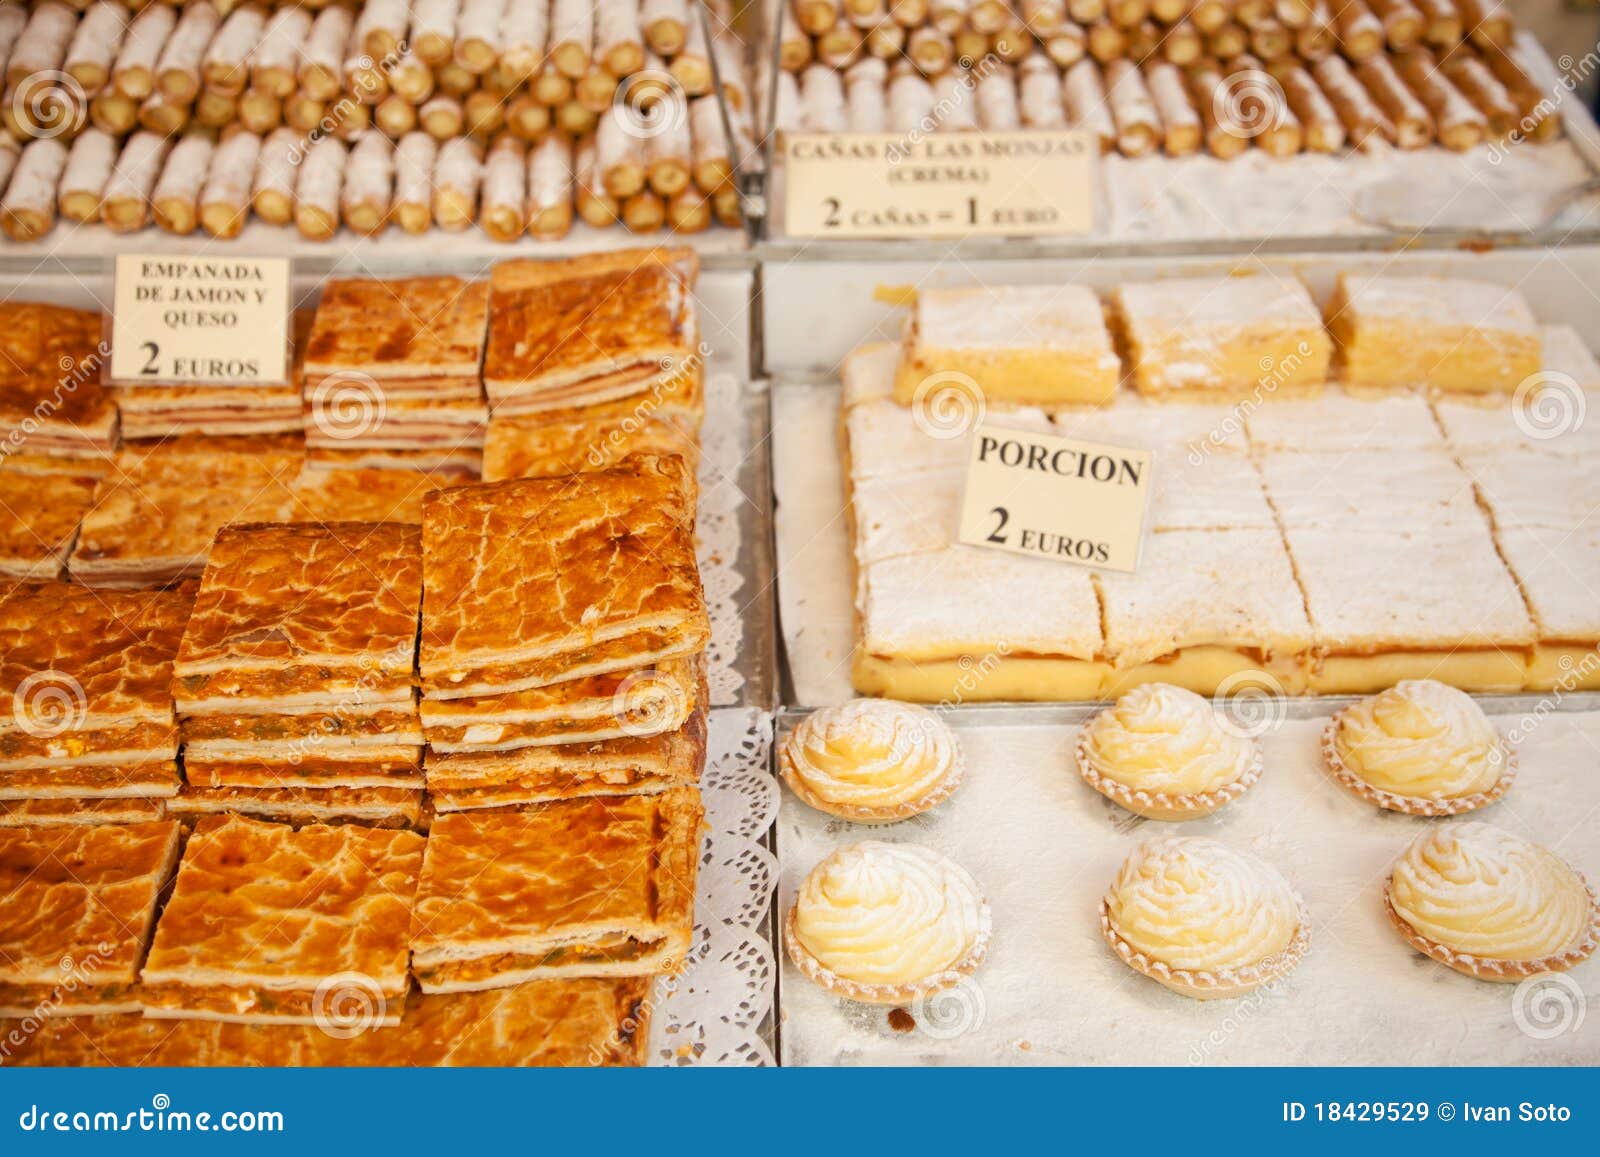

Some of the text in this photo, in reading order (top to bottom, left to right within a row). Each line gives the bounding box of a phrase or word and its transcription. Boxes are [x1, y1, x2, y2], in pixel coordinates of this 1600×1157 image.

[792, 137, 878, 159] CAÑAS
[926, 141, 974, 158] LAS
[821, 197, 842, 227] 2
[851, 205, 930, 227] CAÑAS
[965, 196, 979, 226] 1
[991, 206, 1060, 225] EURO
[141, 261, 264, 280] EMPANADA
[136, 285, 267, 305] DE JAMON Y
[163, 309, 239, 330] QUESO
[139, 340, 260, 378] 2 EUROS
[978, 436, 1144, 487] PORCION
[985, 506, 1111, 563] 2 EUROS
